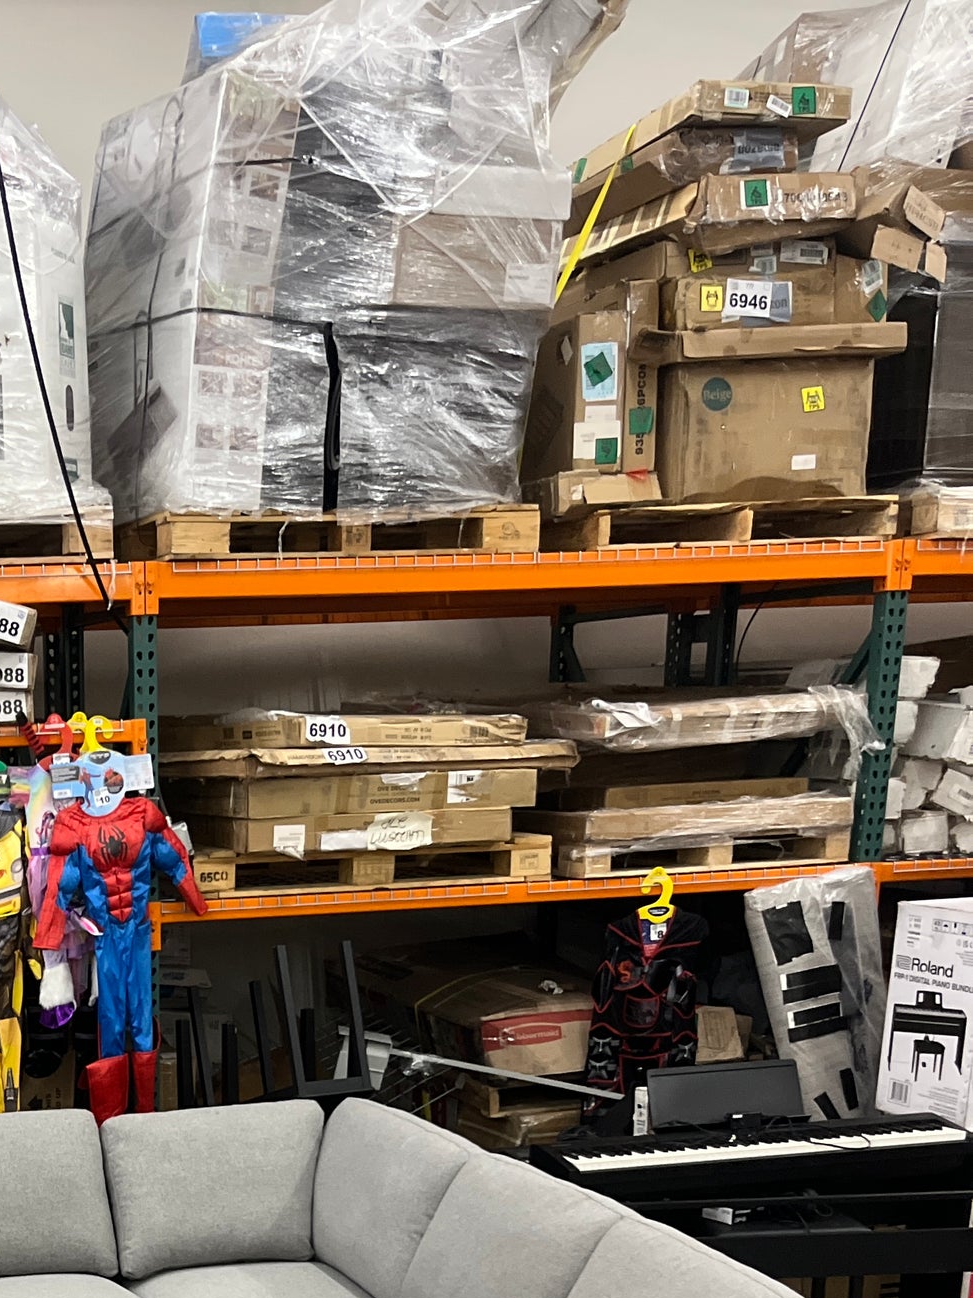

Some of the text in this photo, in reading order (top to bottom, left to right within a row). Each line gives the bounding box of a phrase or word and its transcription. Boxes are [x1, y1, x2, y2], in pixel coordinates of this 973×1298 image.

[729, 293, 768, 310] 6946
[703, 388, 731, 401] Beige
[309, 724, 347, 738] 6910
[328, 748, 363, 762] 6910
[911, 957, 955, 979] Roland
[909, 974, 931, 986] DIGITAL
[931, 978, 951, 990] PIANO
